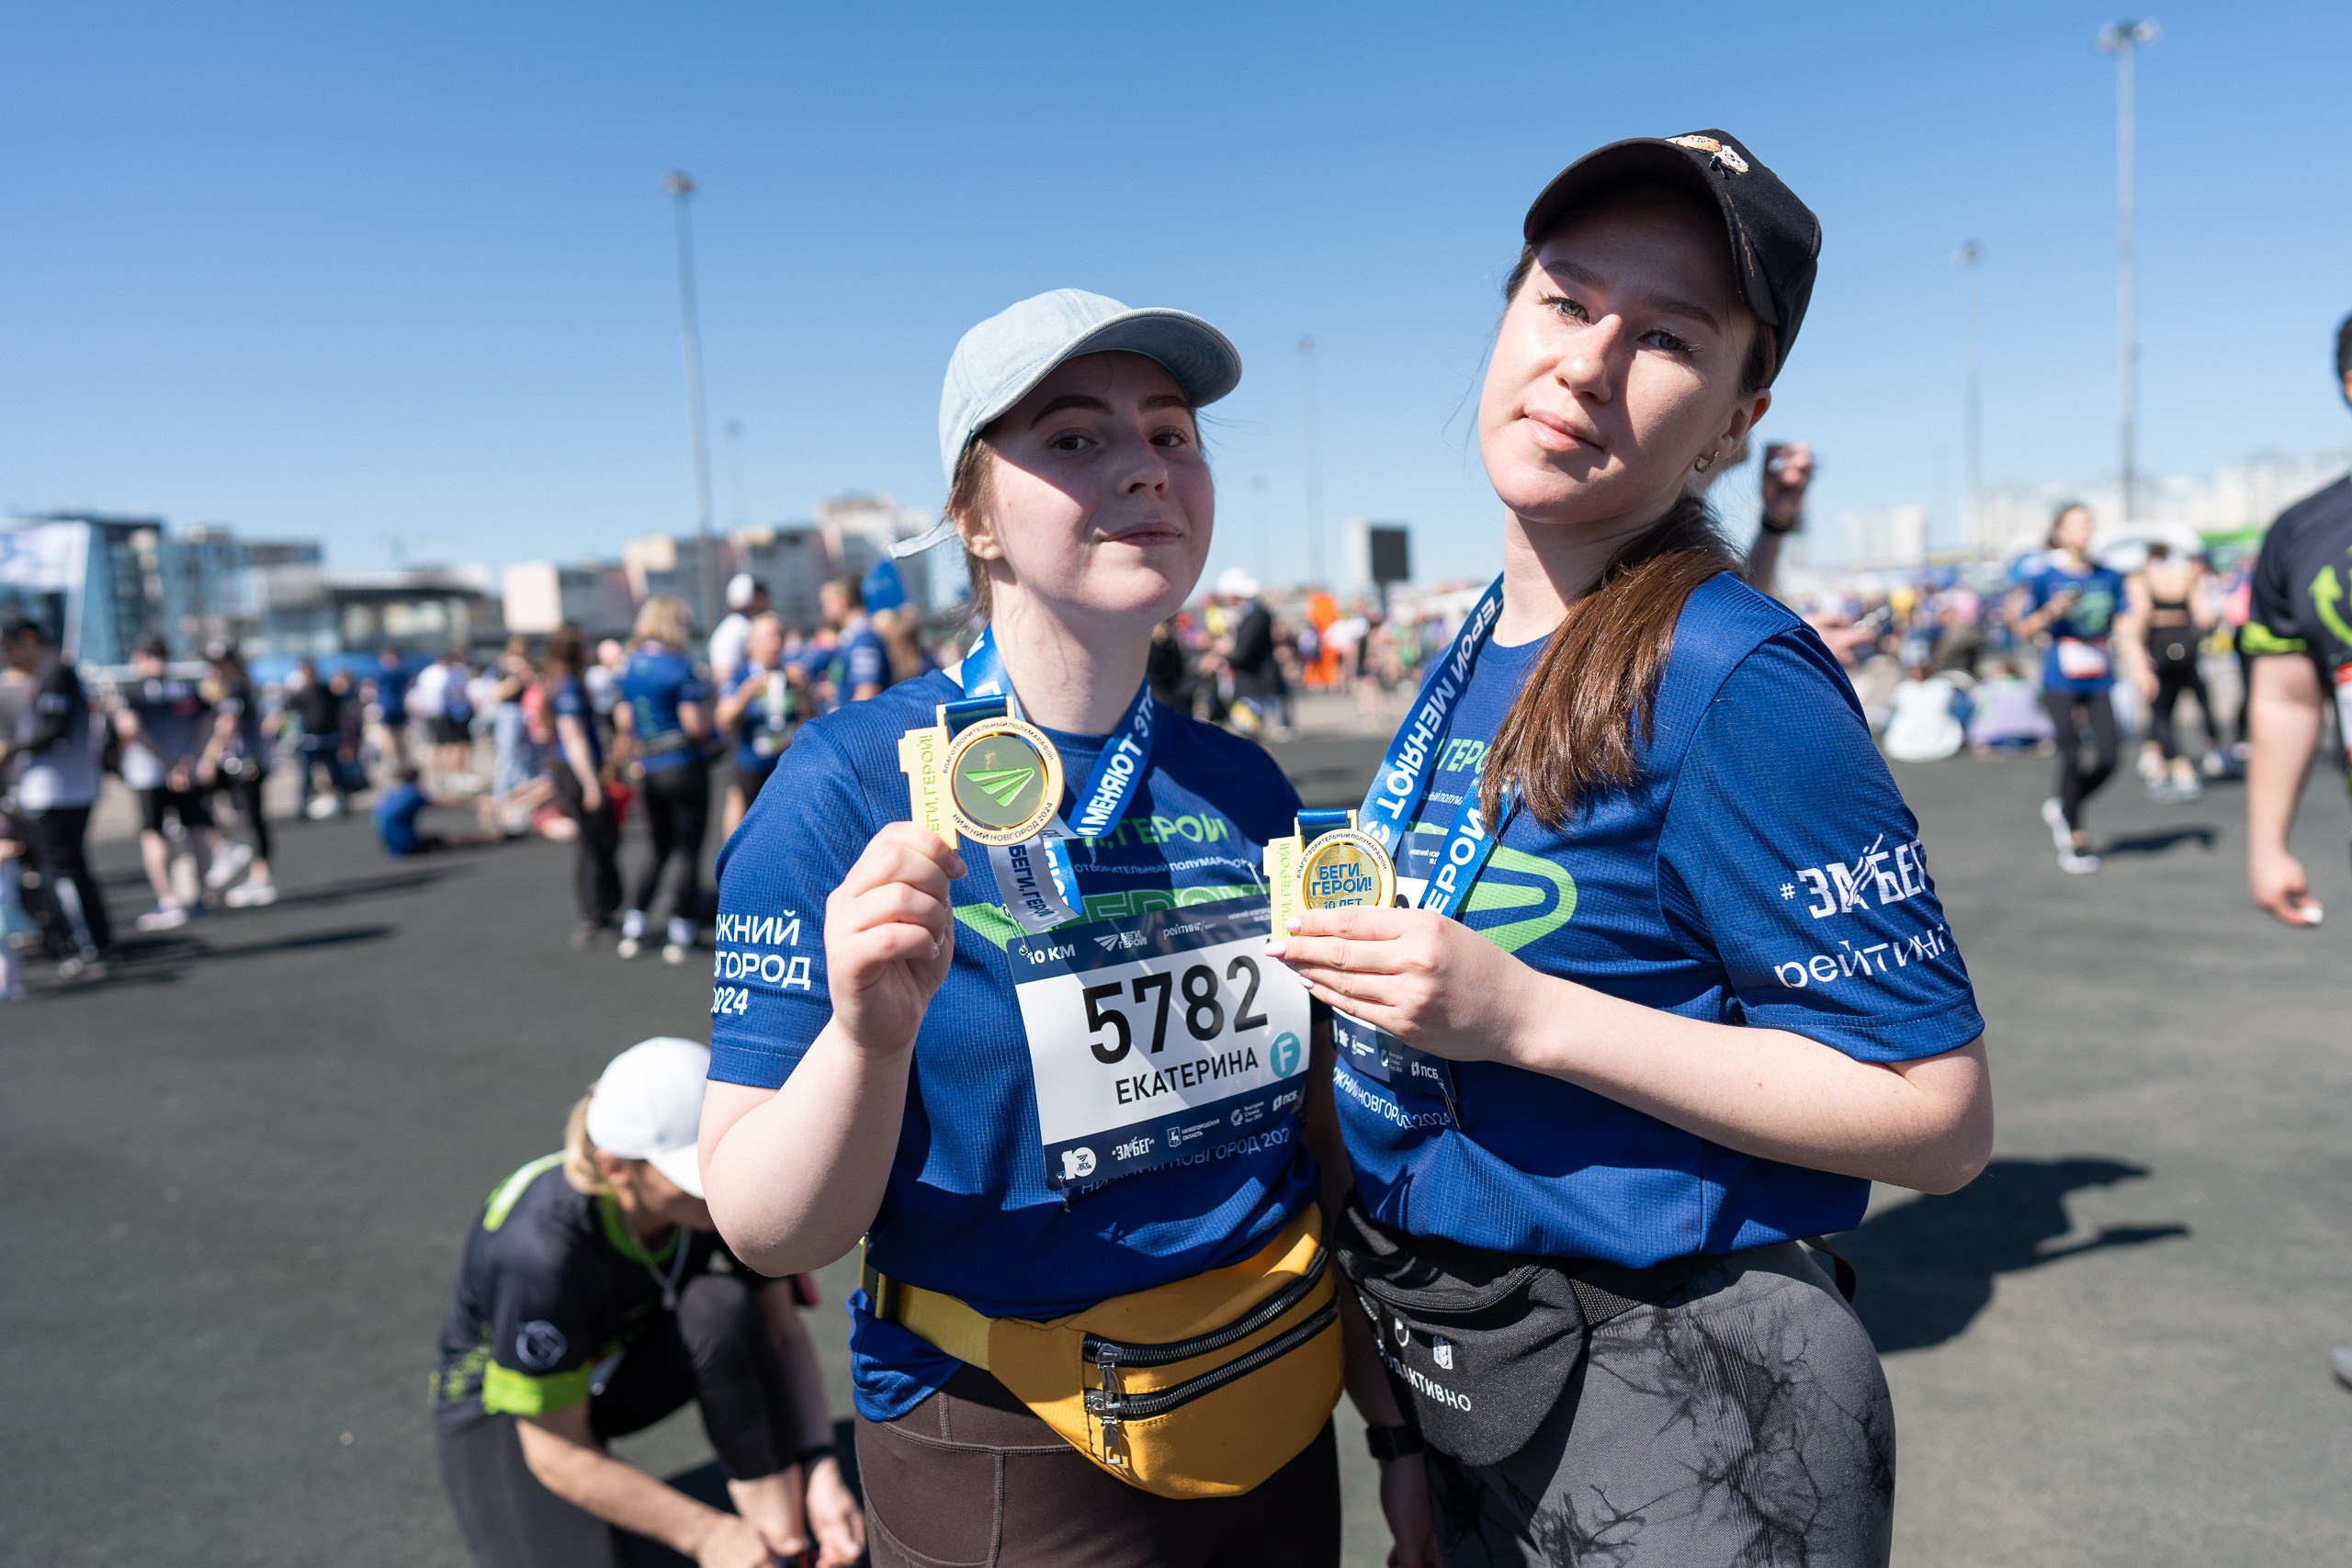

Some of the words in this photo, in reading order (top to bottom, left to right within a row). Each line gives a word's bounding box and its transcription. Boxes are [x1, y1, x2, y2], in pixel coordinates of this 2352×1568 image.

[1450, 590, 1500, 683] ЕРОИ
[917, 735, 939, 796] ГЕРОЙ!
[943, 721, 1008, 774] БЛАГОТВОРИТЕЛЬНЫЙ
[1008, 722, 1055, 761] ПОЛУМАРАФОН
[1376, 676, 1456, 820] МЕНЯЮТ
[1080, 732, 1143, 826] МЕНЯЮТ
[924, 795, 940, 836] ЕГИ,
[952, 813, 990, 841] НИЖНИЙ
[989, 820, 1040, 842] НОВГОРОД
[1037, 801, 1054, 823] 2024
[1008, 844, 1036, 892] БЕГИ,
[1317, 863, 1364, 881] БЕГИ,
[1351, 833, 1387, 870] ПОЛУМАРАФОН
[1423, 807, 1486, 914] ЕРОИ
[1311, 875, 1373, 897] ГЕРОЙ!
[716, 909, 801, 946] ЖНИЙ
[714, 950, 811, 991] ГОРОД
[1081, 954, 1268, 1065] 5782
[1115, 1046, 1259, 1106] ЕКАТЕРИНА
[1276, 1037, 1294, 1073] F
[1420, 1066, 1439, 1079] ПСБ
